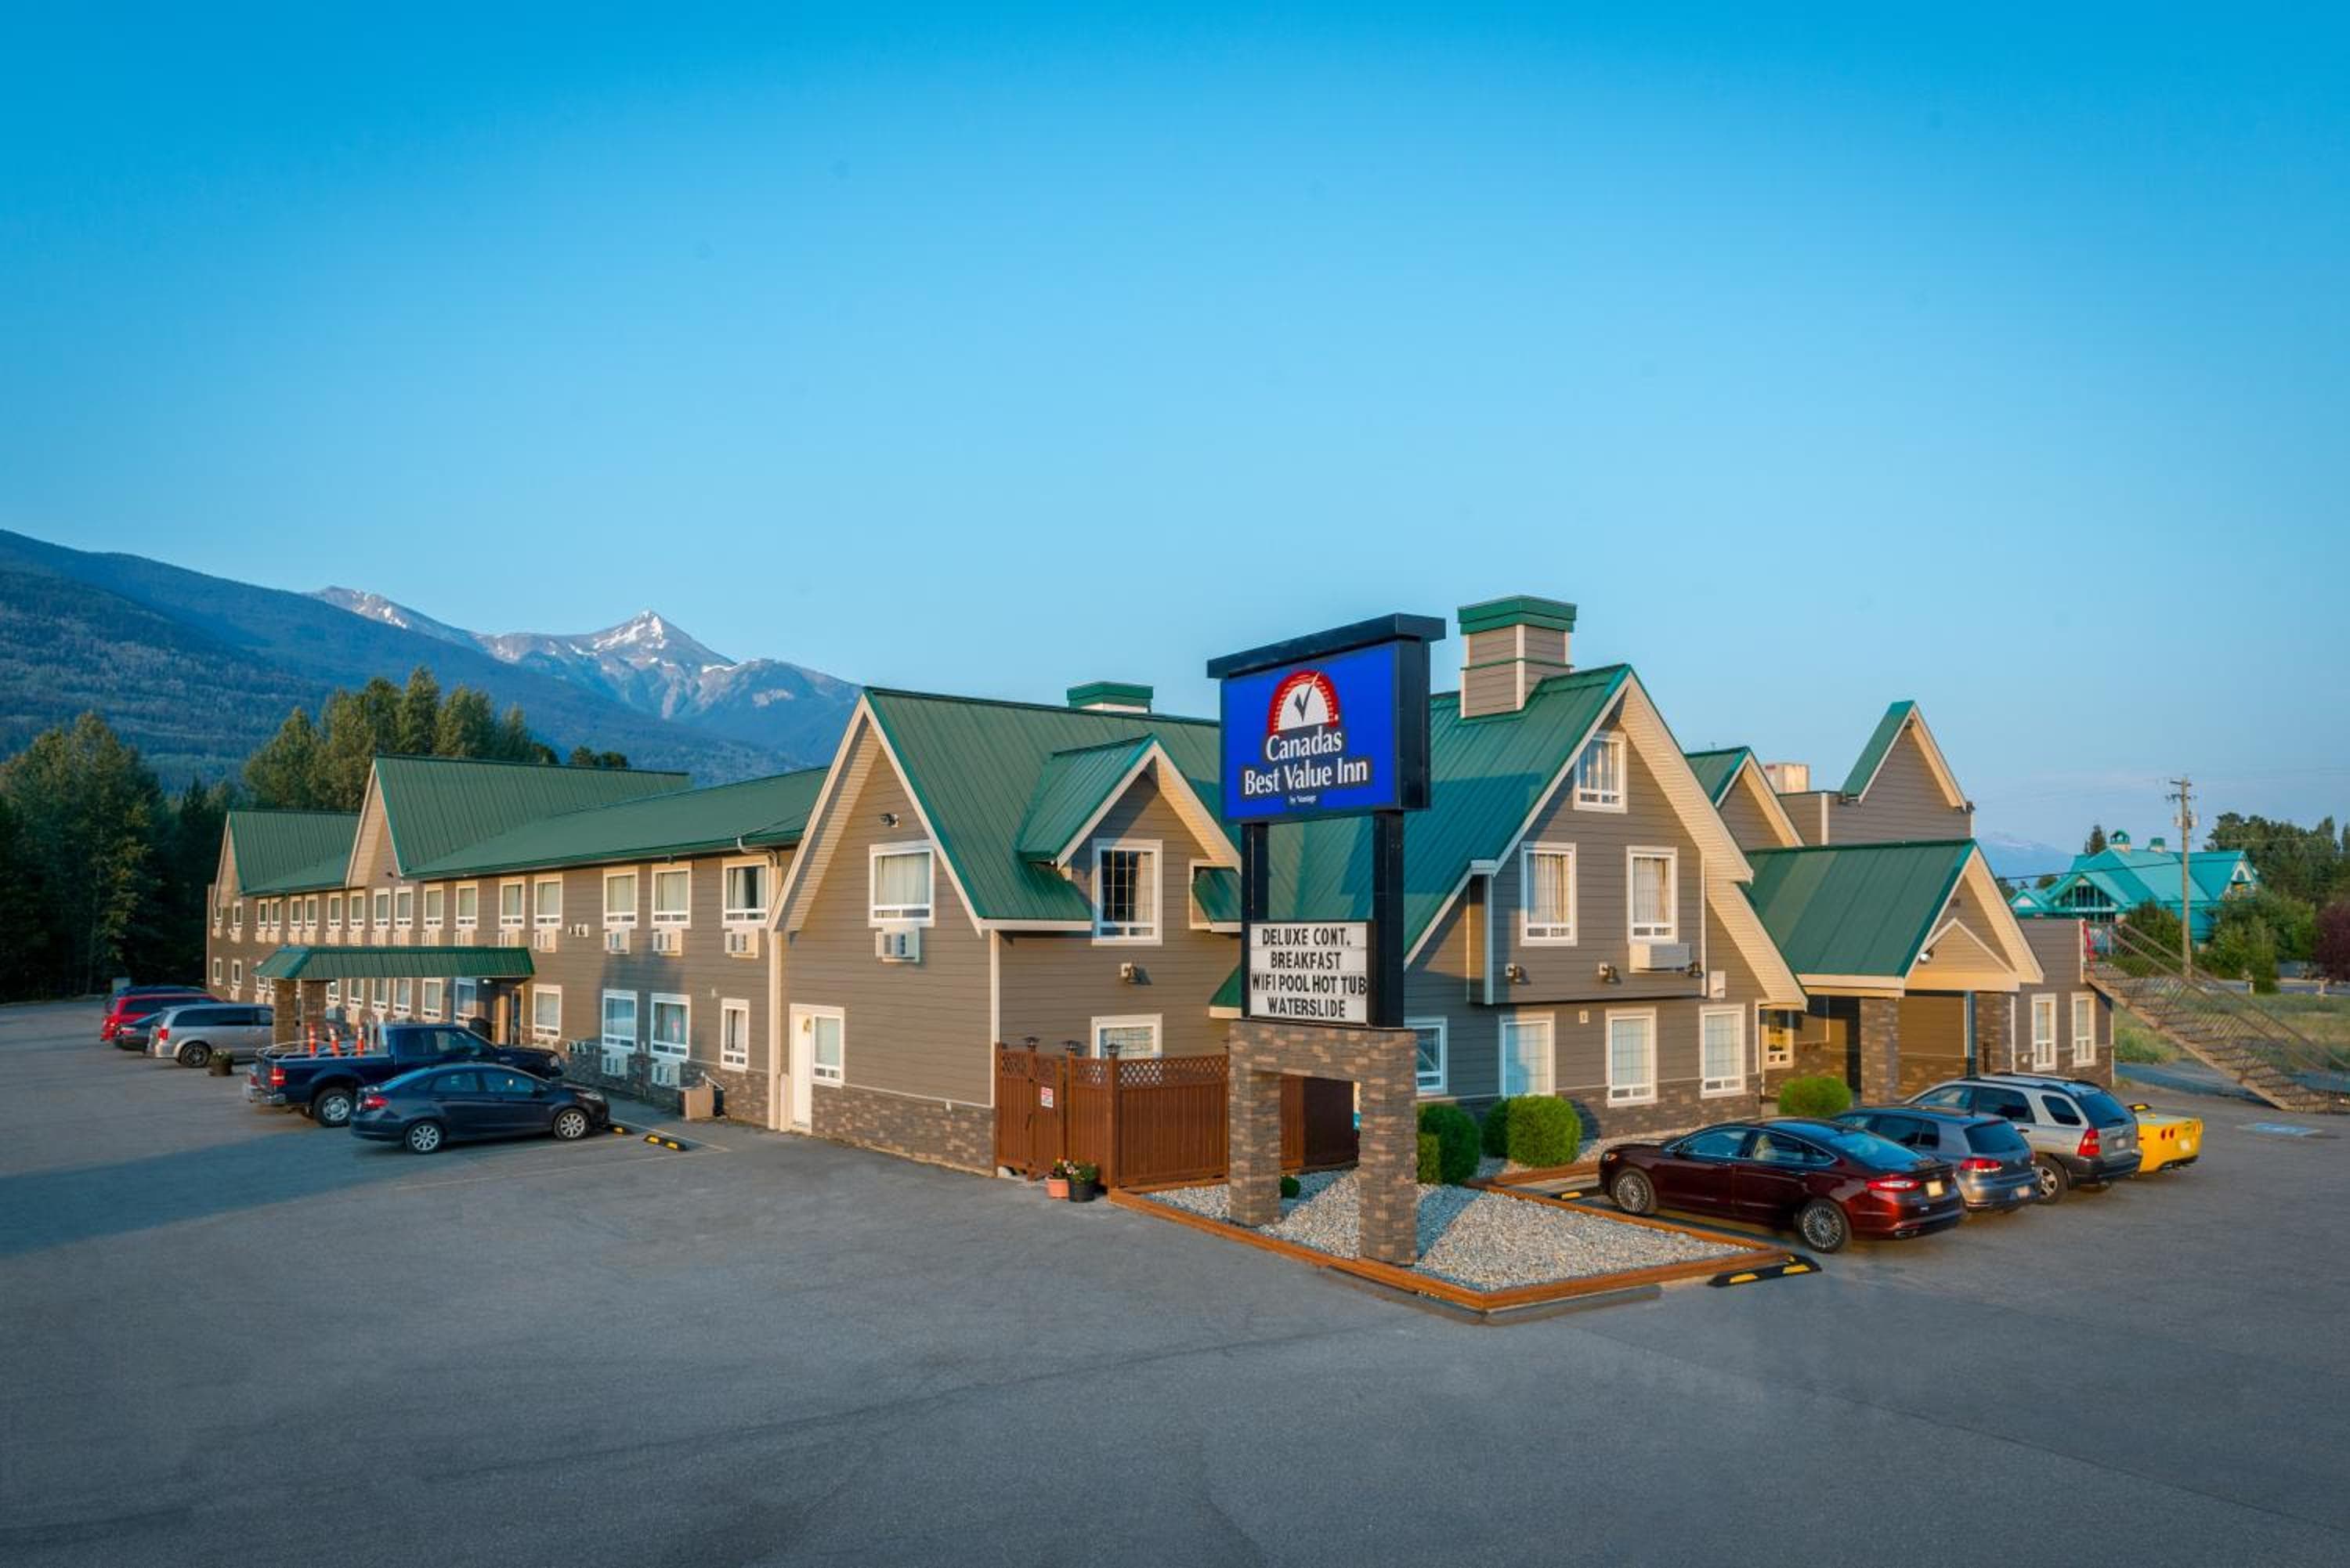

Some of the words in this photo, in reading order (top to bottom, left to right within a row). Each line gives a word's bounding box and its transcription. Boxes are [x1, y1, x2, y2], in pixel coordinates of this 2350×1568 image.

[1266, 725, 1343, 761] Canadas
[1244, 769, 1279, 796] Best
[1284, 760, 1332, 789] Value
[1337, 758, 1368, 783] Inn
[1262, 928, 1309, 946] DELUXE
[1313, 927, 1351, 946] CONT.
[1271, 952, 1342, 970] BREAKFAST
[1252, 974, 1276, 991] WIFI
[1279, 975, 1311, 992] POOL
[1312, 977, 1340, 994] HOT
[1340, 978, 1367, 995] TUB
[1267, 997, 1346, 1017] WATERSLIDE
